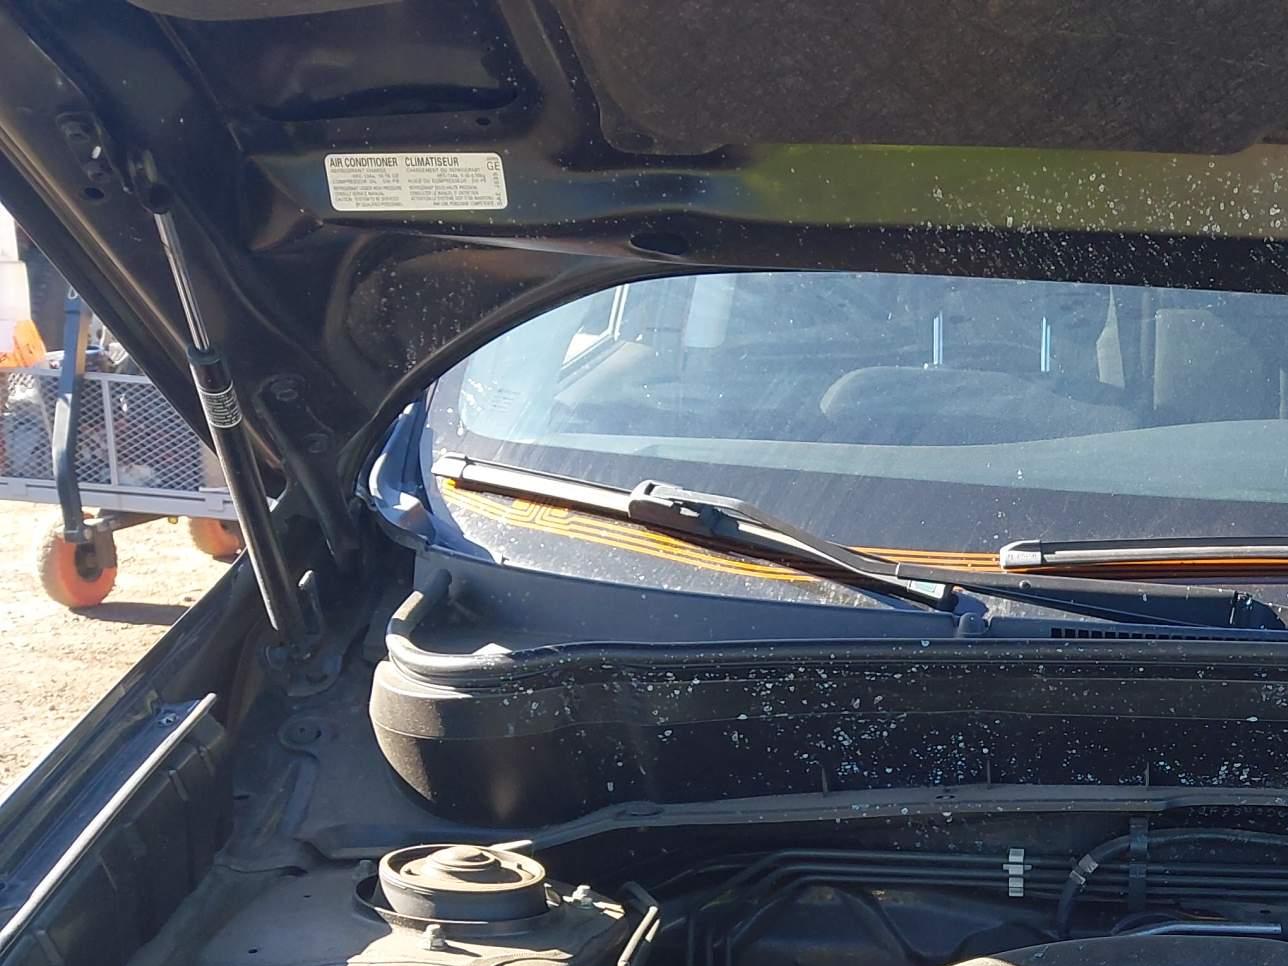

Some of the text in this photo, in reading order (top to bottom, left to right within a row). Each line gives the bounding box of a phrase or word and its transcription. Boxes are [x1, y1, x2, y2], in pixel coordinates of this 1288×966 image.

[330, 157, 399, 168] AIR CONDITIONER
[405, 156, 460, 167] CLIMATISEUR
[486, 161, 500, 171] GE
